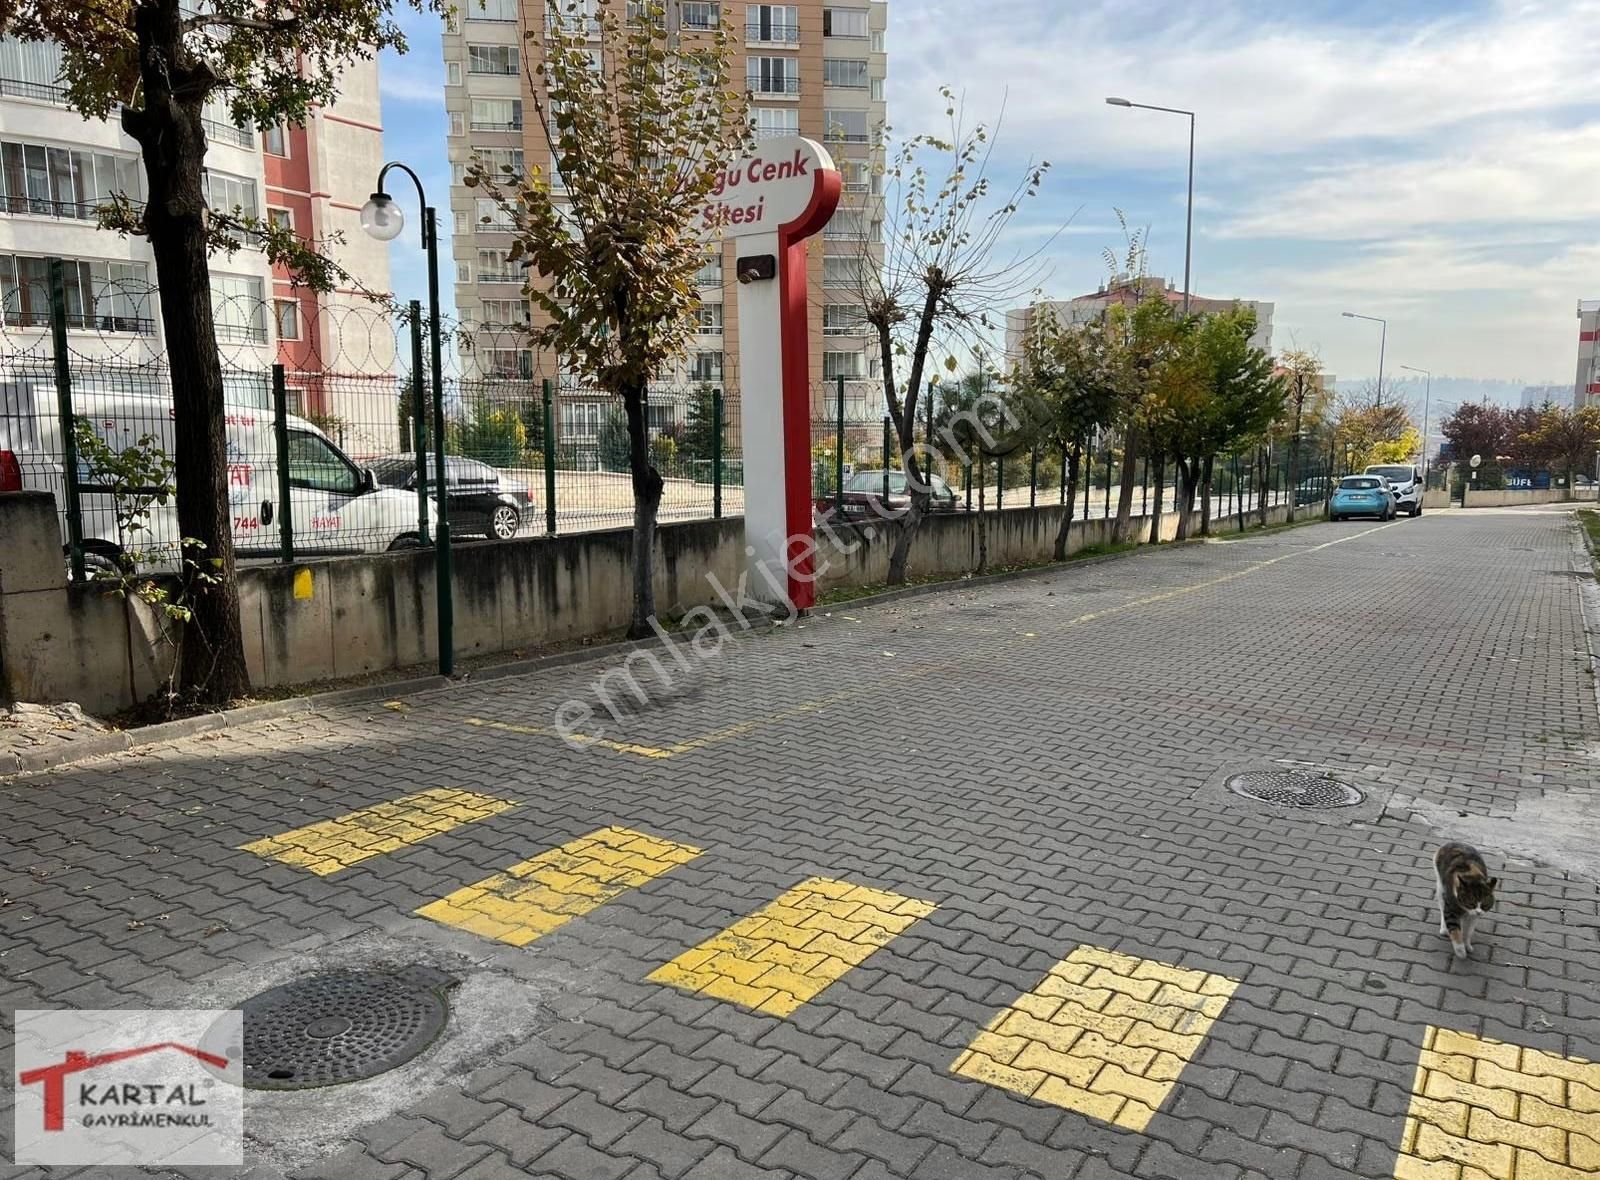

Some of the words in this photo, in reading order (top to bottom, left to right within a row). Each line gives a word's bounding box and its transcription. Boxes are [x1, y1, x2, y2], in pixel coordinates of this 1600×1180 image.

[746, 149, 811, 184] Cenk
[233, 516, 258, 530] 744
[311, 516, 342, 529] HAYAT
